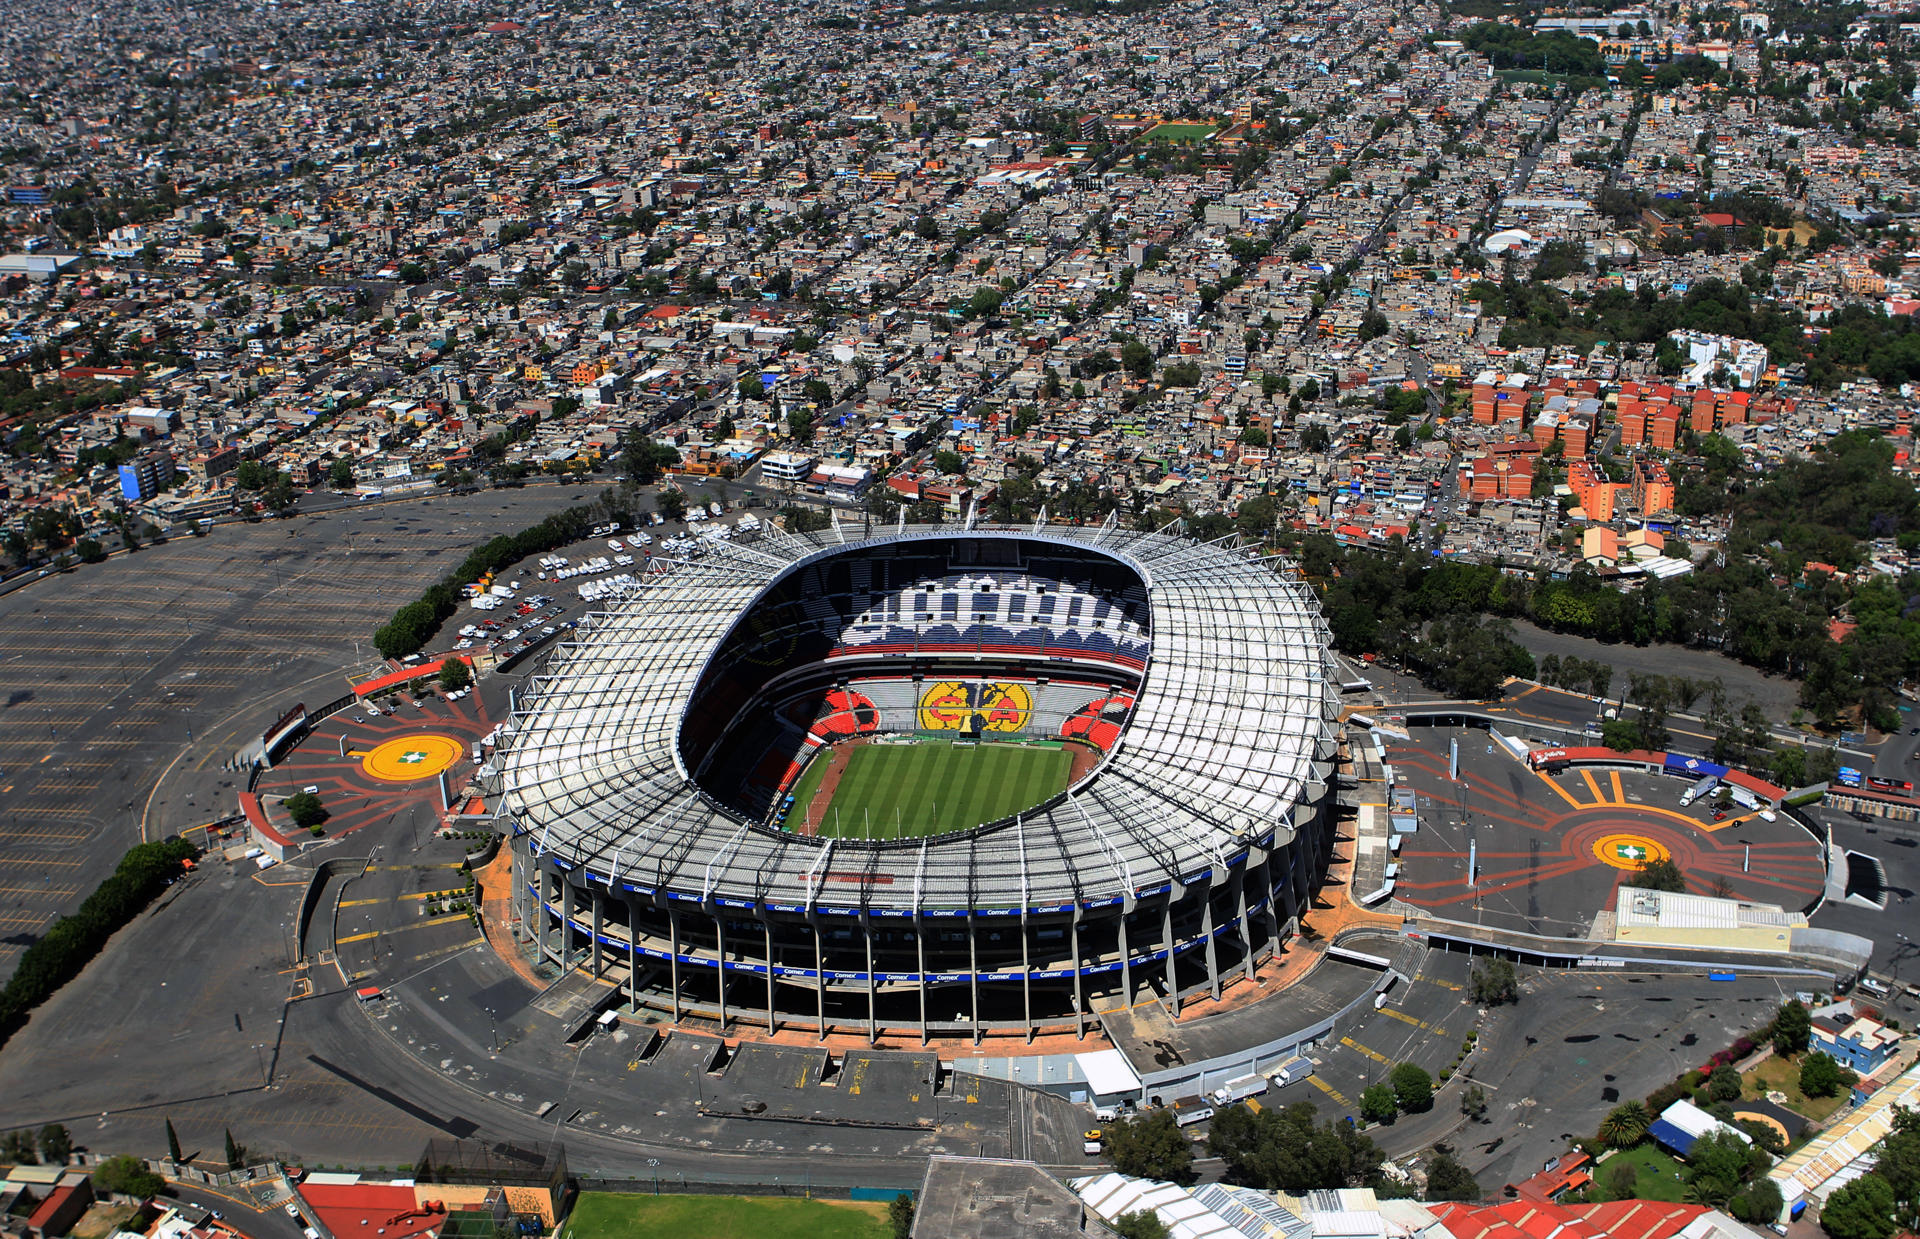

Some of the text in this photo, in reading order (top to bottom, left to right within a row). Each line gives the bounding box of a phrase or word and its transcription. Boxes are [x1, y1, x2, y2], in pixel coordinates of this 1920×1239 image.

[930, 696, 1019, 723] C A
[1184, 875, 1203, 885] Comex
[1140, 888, 1161, 898] Comex
[724, 900, 746, 908] Comex
[1091, 899, 1113, 908] Comex
[1038, 905, 1061, 913] Comex
[644, 949, 664, 958] Comex
[688, 957, 709, 965] Comex
[734, 963, 755, 971] Comex
[1089, 964, 1112, 973] Comex
[1040, 970, 1063, 978] Comex
